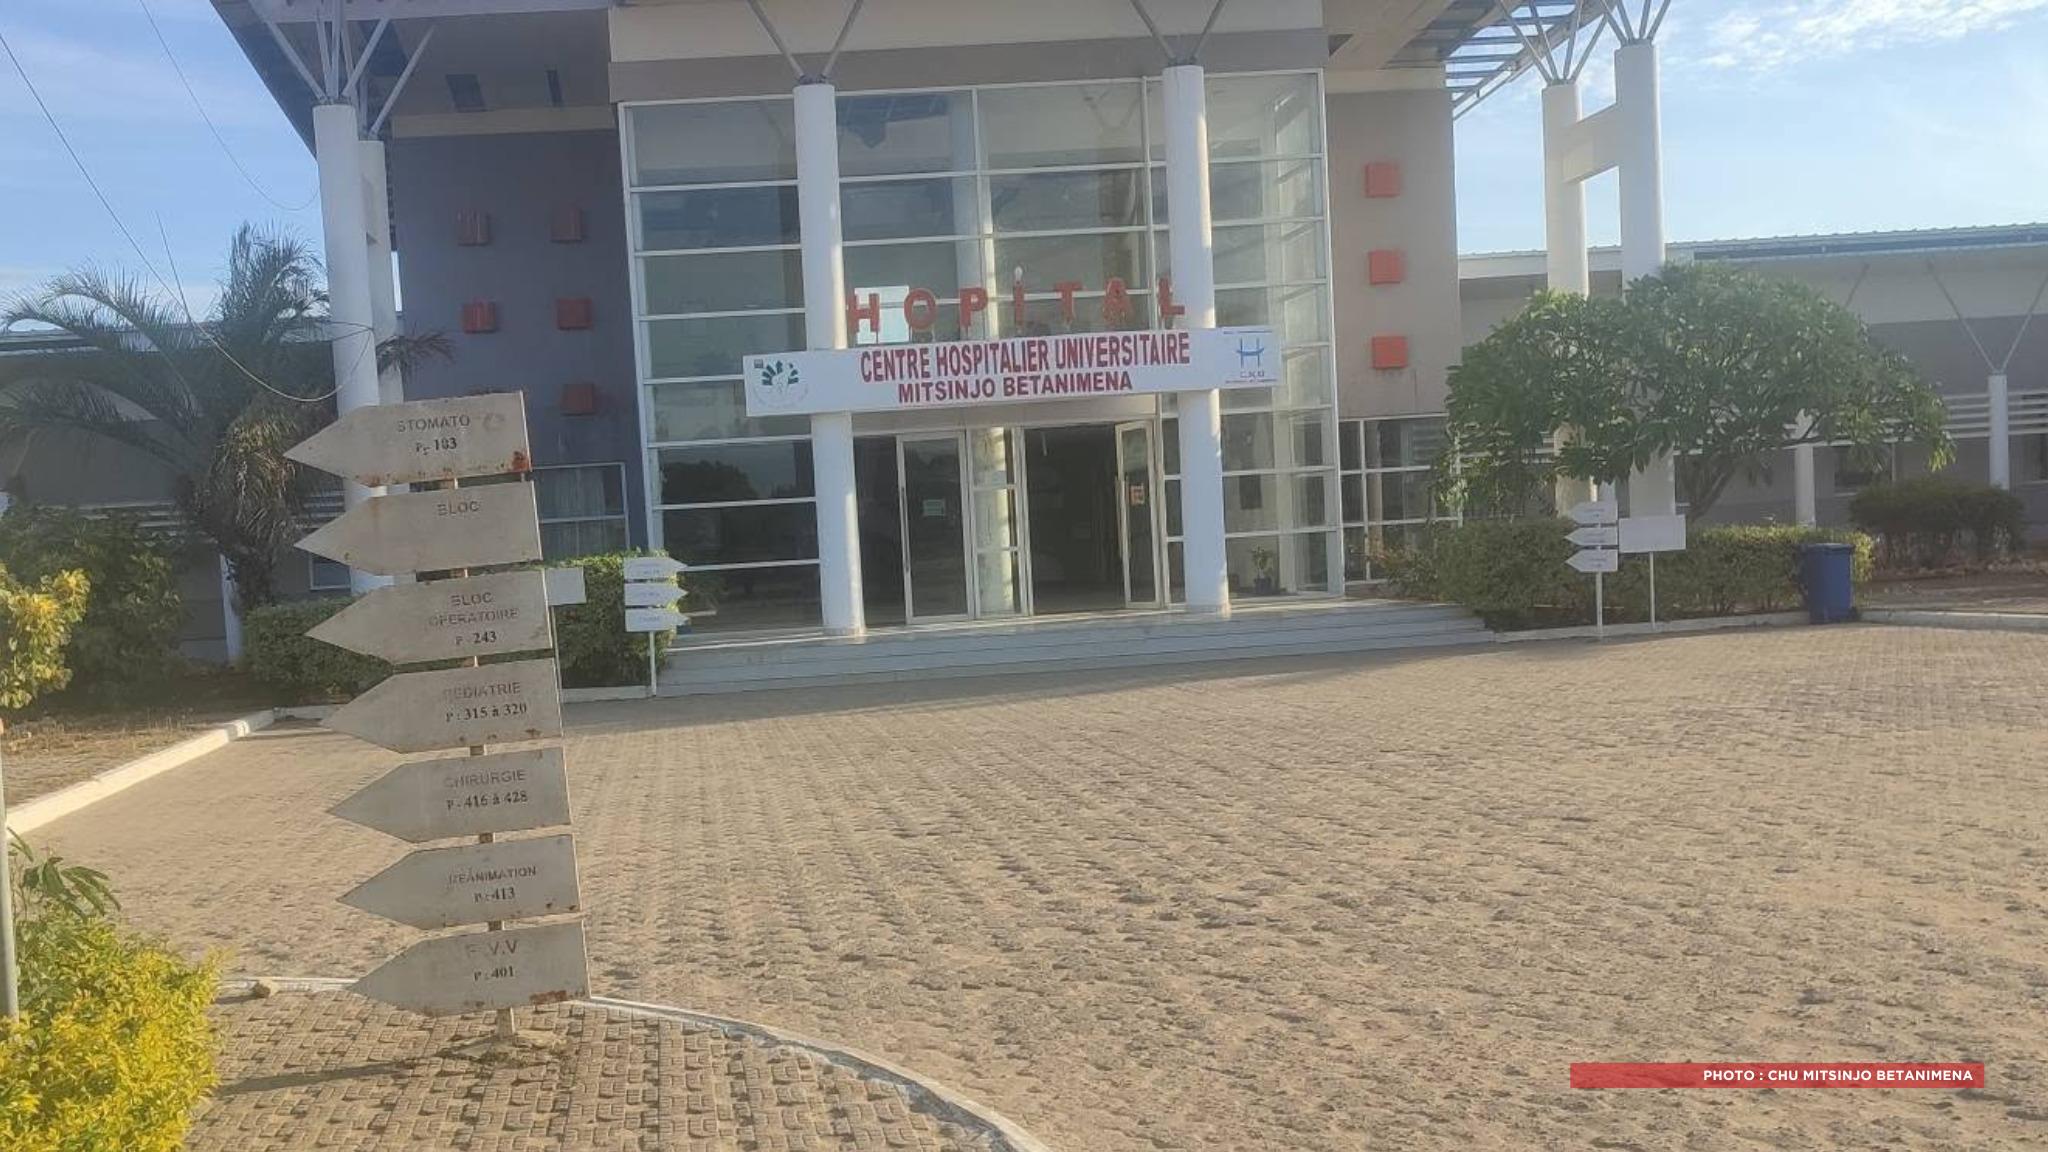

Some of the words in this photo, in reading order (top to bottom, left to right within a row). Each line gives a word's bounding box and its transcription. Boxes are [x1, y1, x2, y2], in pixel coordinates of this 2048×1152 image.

[860, 347, 931, 383] CENTRE
[936, 339, 1049, 377] HOSPITALIER
[1054, 332, 1190, 369] UNIVERSITAIRE
[898, 377, 995, 403] MITSINJO
[1003, 371, 1133, 397] BETANIMENA
[397, 415, 471, 433] STOMATO
[472, 630, 497, 644] 243
[463, 706, 488, 721] 315
[503, 702, 527, 717] 320
[463, 794, 489, 808] 416
[491, 965, 514, 979] 401
